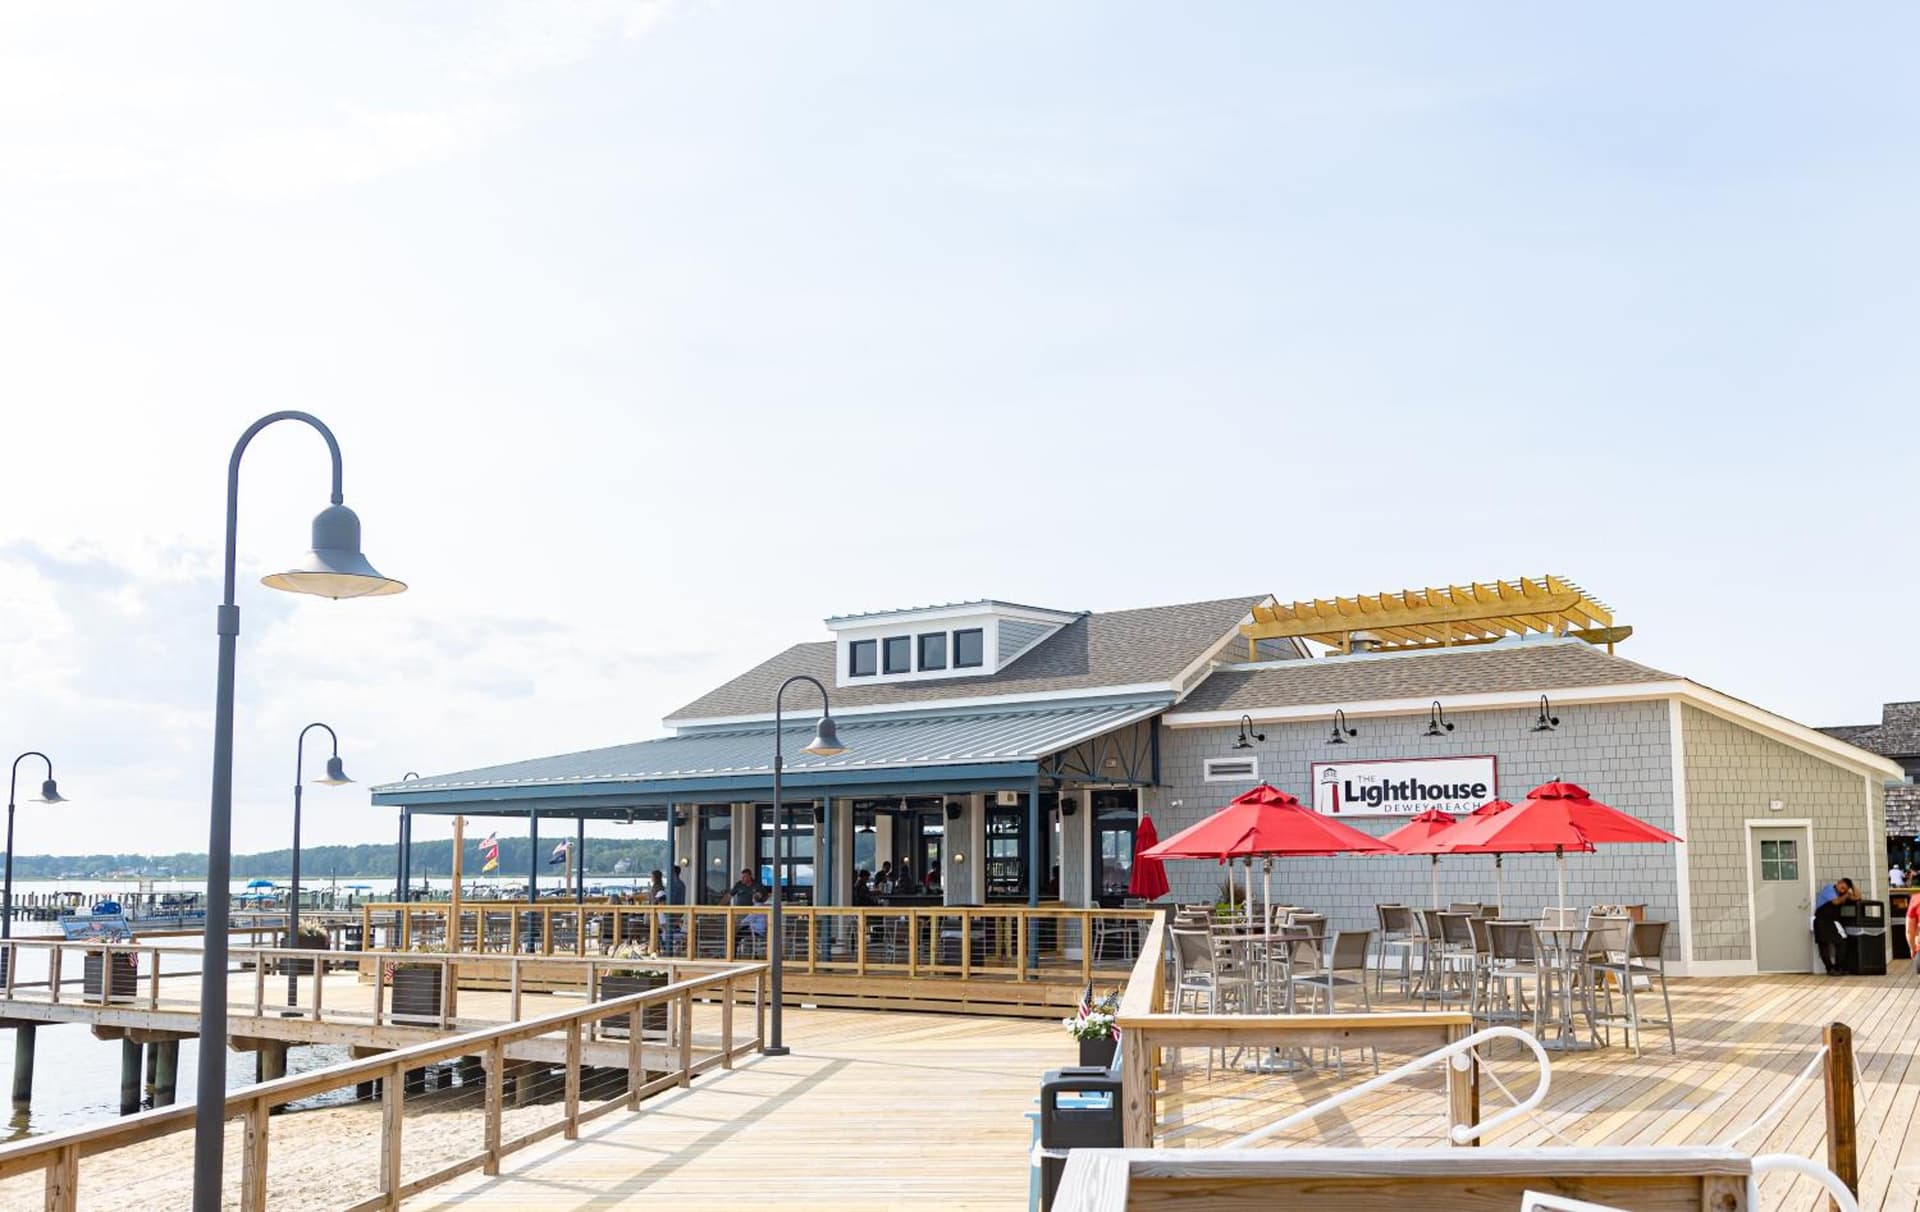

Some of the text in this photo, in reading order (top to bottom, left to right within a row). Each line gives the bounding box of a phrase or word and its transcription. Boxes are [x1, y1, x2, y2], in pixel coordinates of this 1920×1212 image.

[1358, 775, 1376, 783] THE
[1345, 778, 1487, 807] Lighthouse
[1384, 801, 1482, 813] DEWEY BEACH
